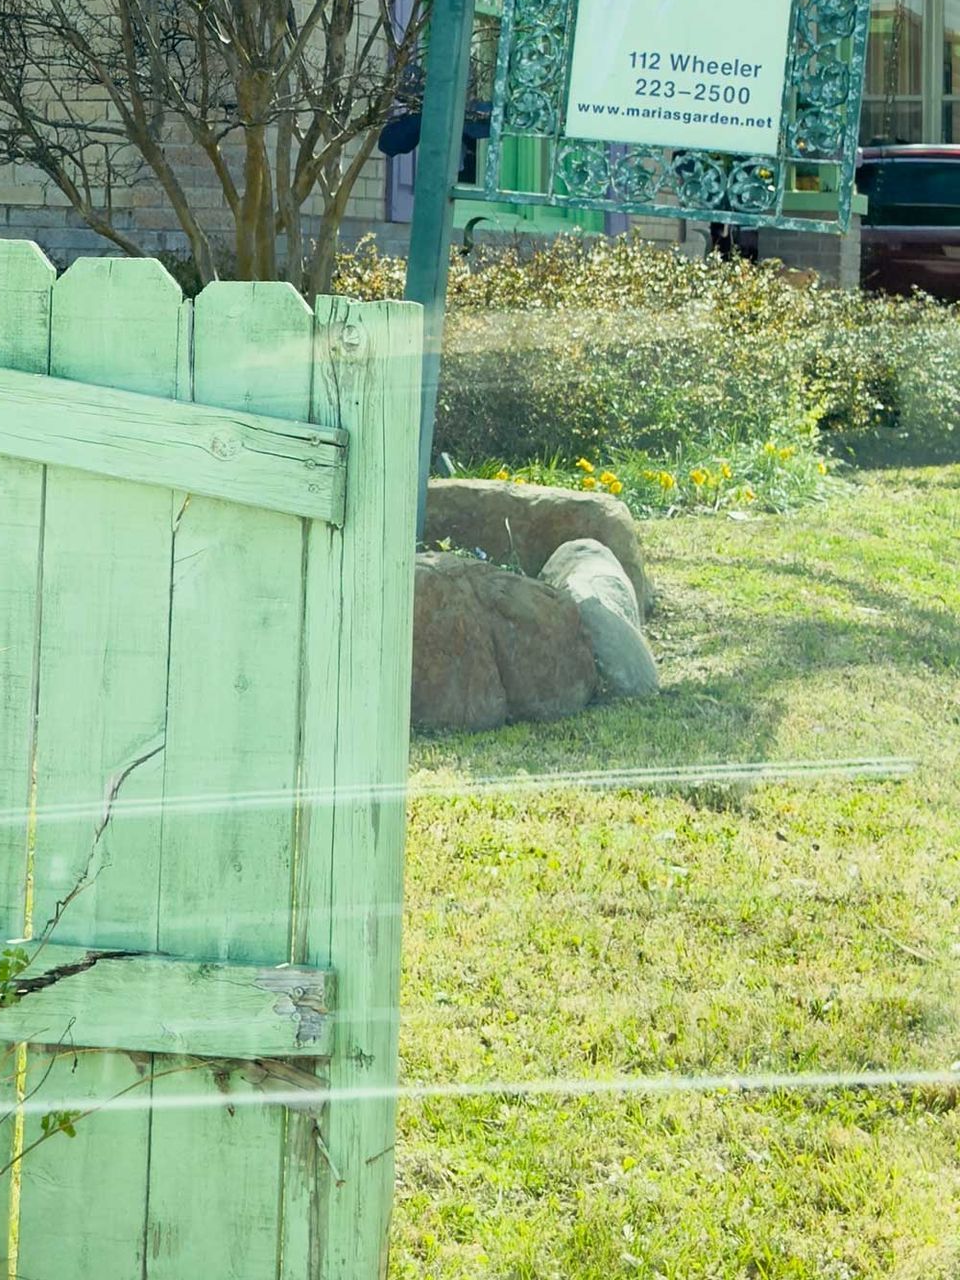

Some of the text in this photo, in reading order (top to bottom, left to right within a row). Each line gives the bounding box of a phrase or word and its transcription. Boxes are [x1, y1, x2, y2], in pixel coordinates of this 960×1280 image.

[629, 51, 762, 78] 112 Wheeler
[635, 78, 751, 105] 223-2500
[577, 101, 772, 128] www.mariasgarden.net
